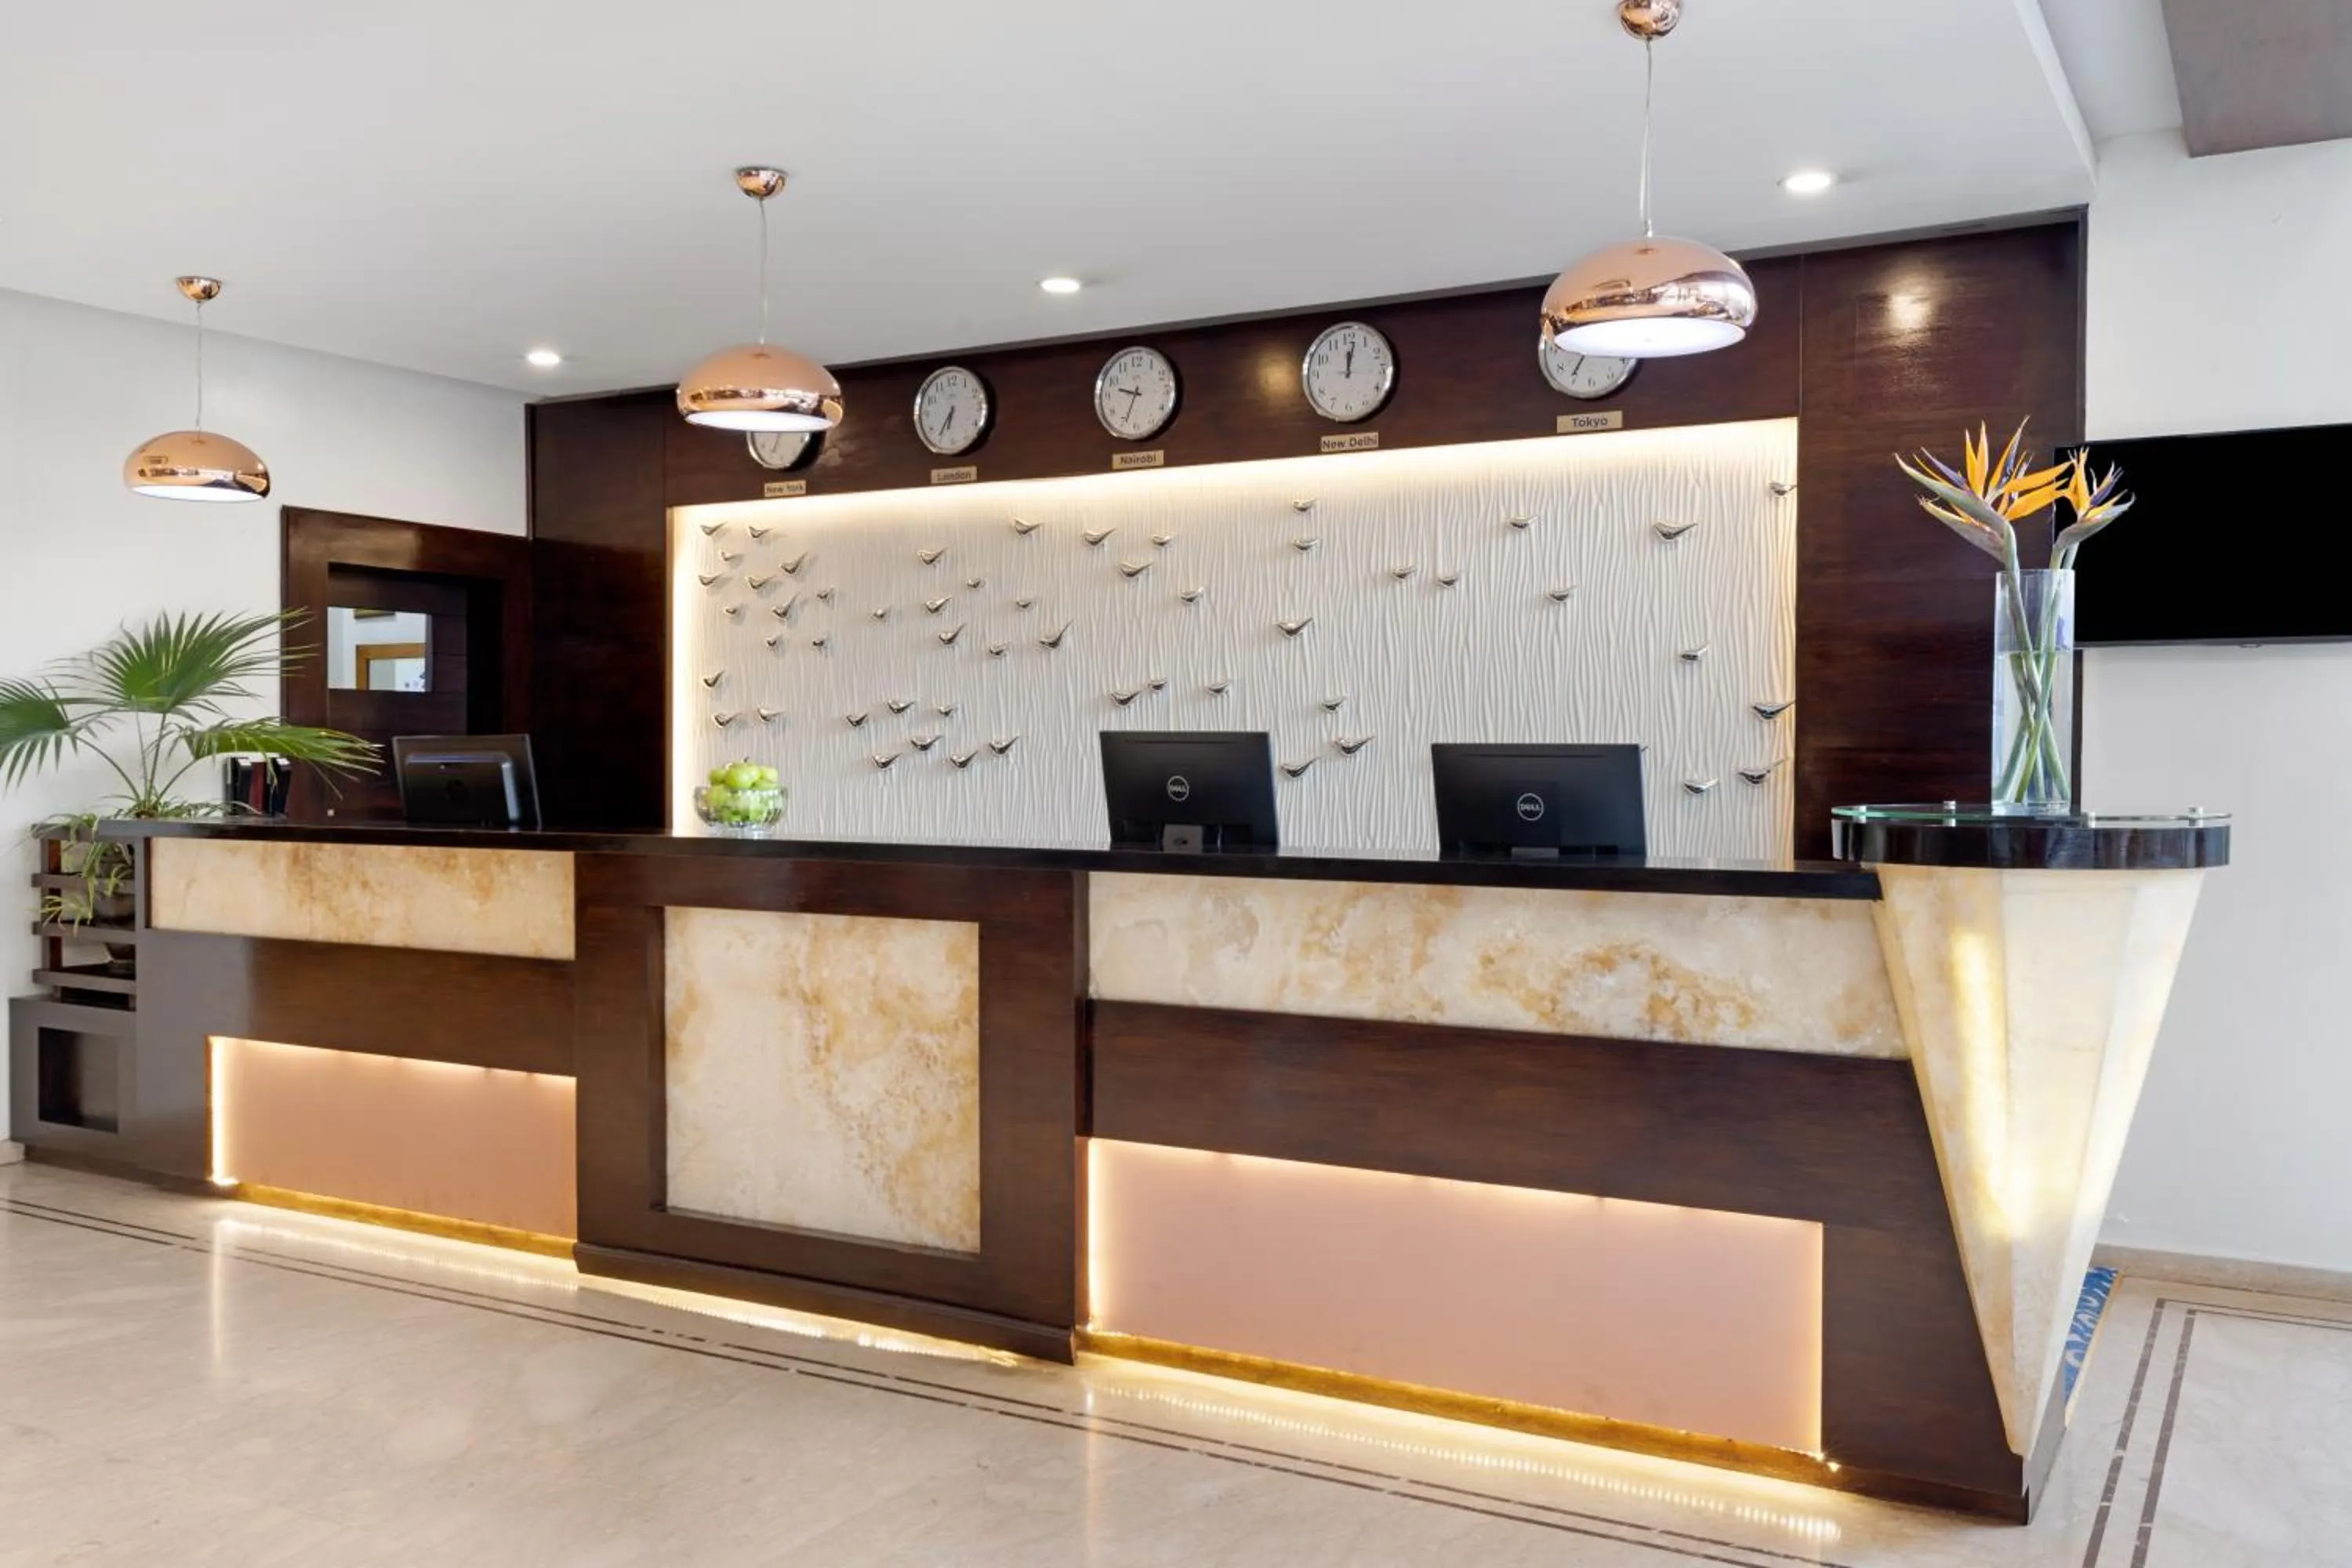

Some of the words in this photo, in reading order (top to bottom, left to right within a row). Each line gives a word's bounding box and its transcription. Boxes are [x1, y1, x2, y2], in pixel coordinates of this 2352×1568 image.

[1571, 416, 1608, 428] Tokyo
[1322, 439, 1346, 450] New
[1349, 434, 1378, 448] Delhi
[1120, 453, 1156, 465] Nairobi
